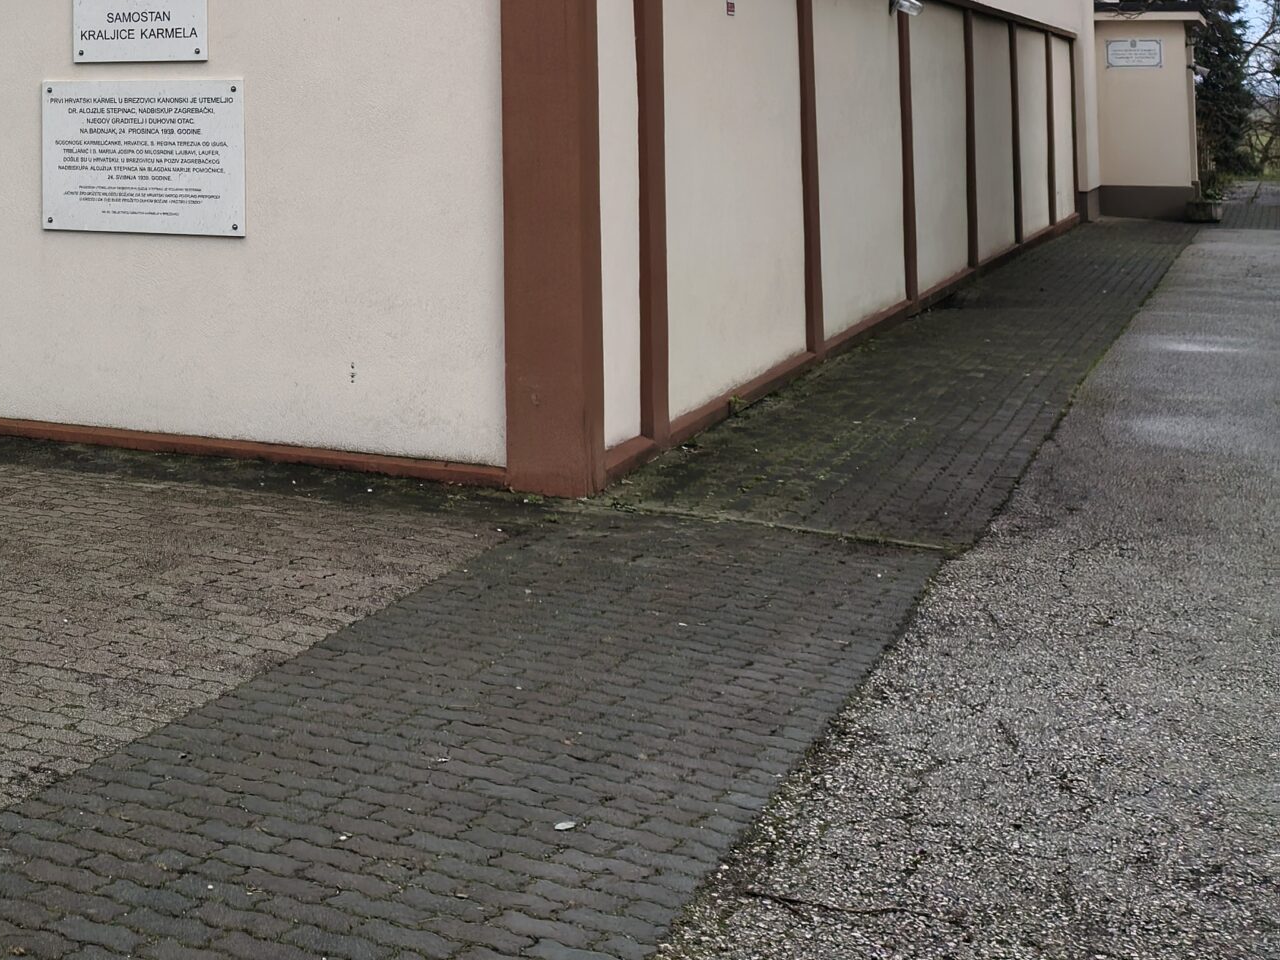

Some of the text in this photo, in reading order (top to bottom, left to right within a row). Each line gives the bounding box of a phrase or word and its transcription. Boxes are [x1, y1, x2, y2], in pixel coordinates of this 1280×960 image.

[106, 10, 171, 24] SAMOSTAN
[80, 27, 198, 41] KRALJICE KARMELA
